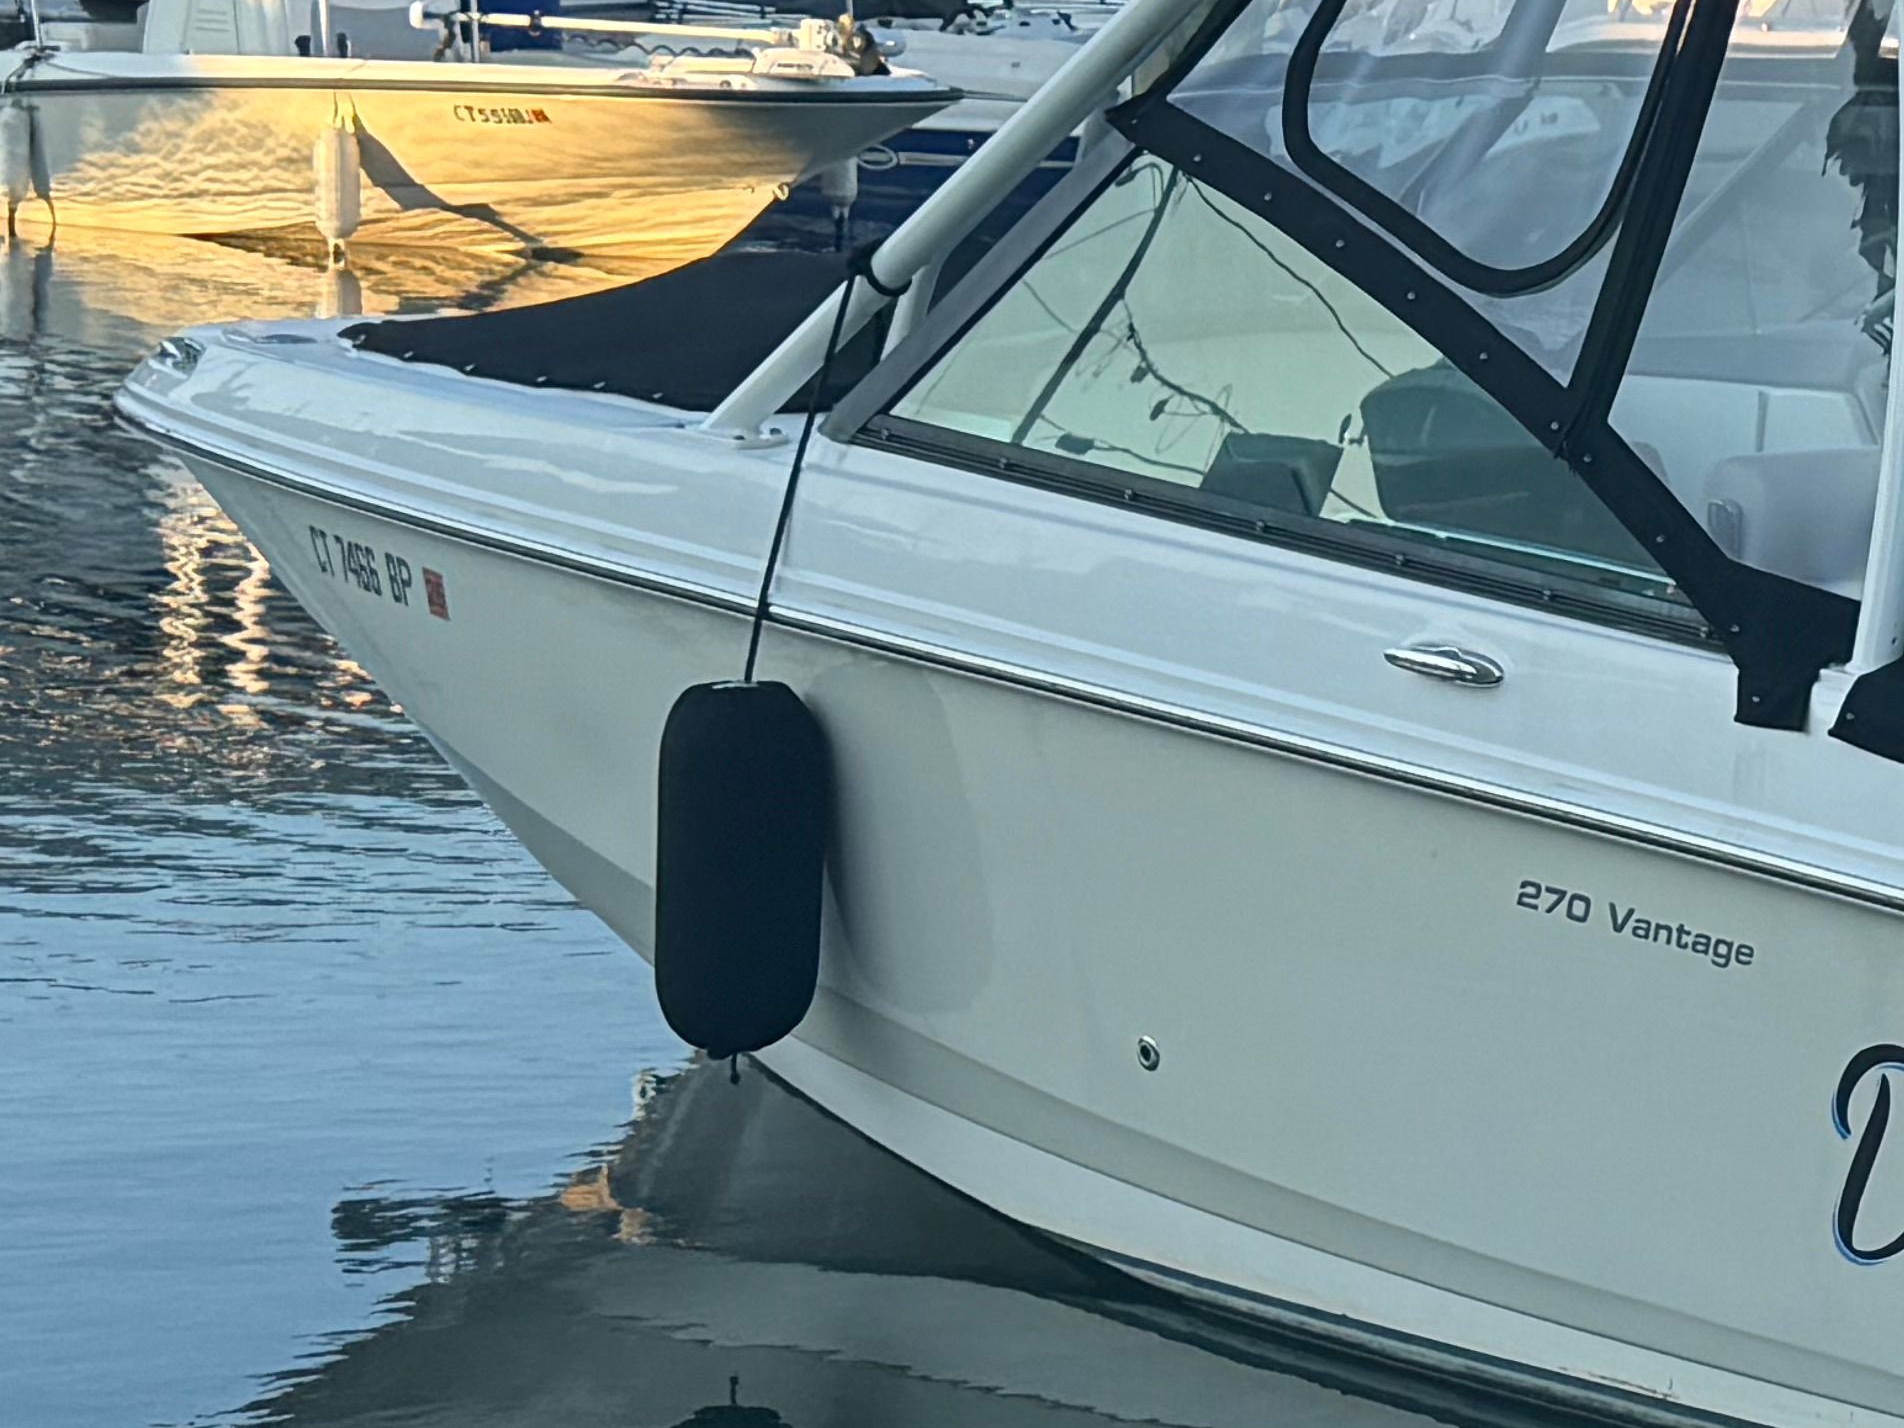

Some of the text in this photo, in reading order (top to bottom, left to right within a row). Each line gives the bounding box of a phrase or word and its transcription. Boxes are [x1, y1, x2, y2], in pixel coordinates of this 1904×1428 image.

[309, 525, 334, 577] CT
[384, 551, 412, 606] BP
[1516, 879, 1755, 968] 270 Vantage
